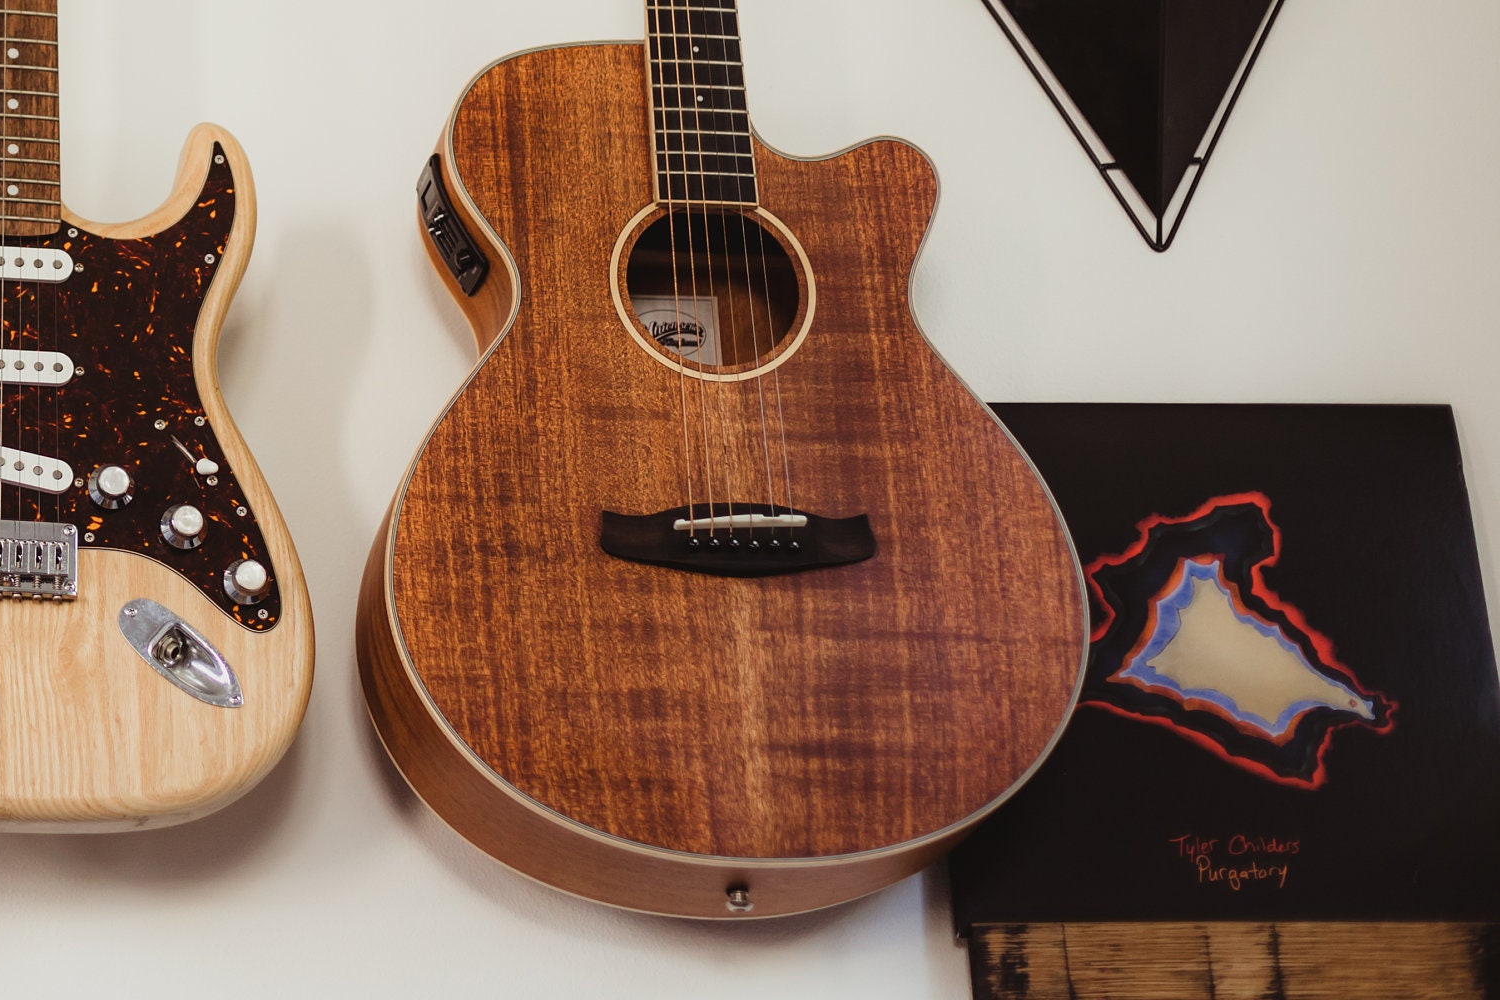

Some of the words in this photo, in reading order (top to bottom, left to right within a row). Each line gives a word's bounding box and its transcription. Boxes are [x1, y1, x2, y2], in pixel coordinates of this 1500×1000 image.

[1168, 834, 1219, 863] Tyler
[1227, 834, 1300, 856] Childers
[1196, 855, 1288, 891] Purgatory
